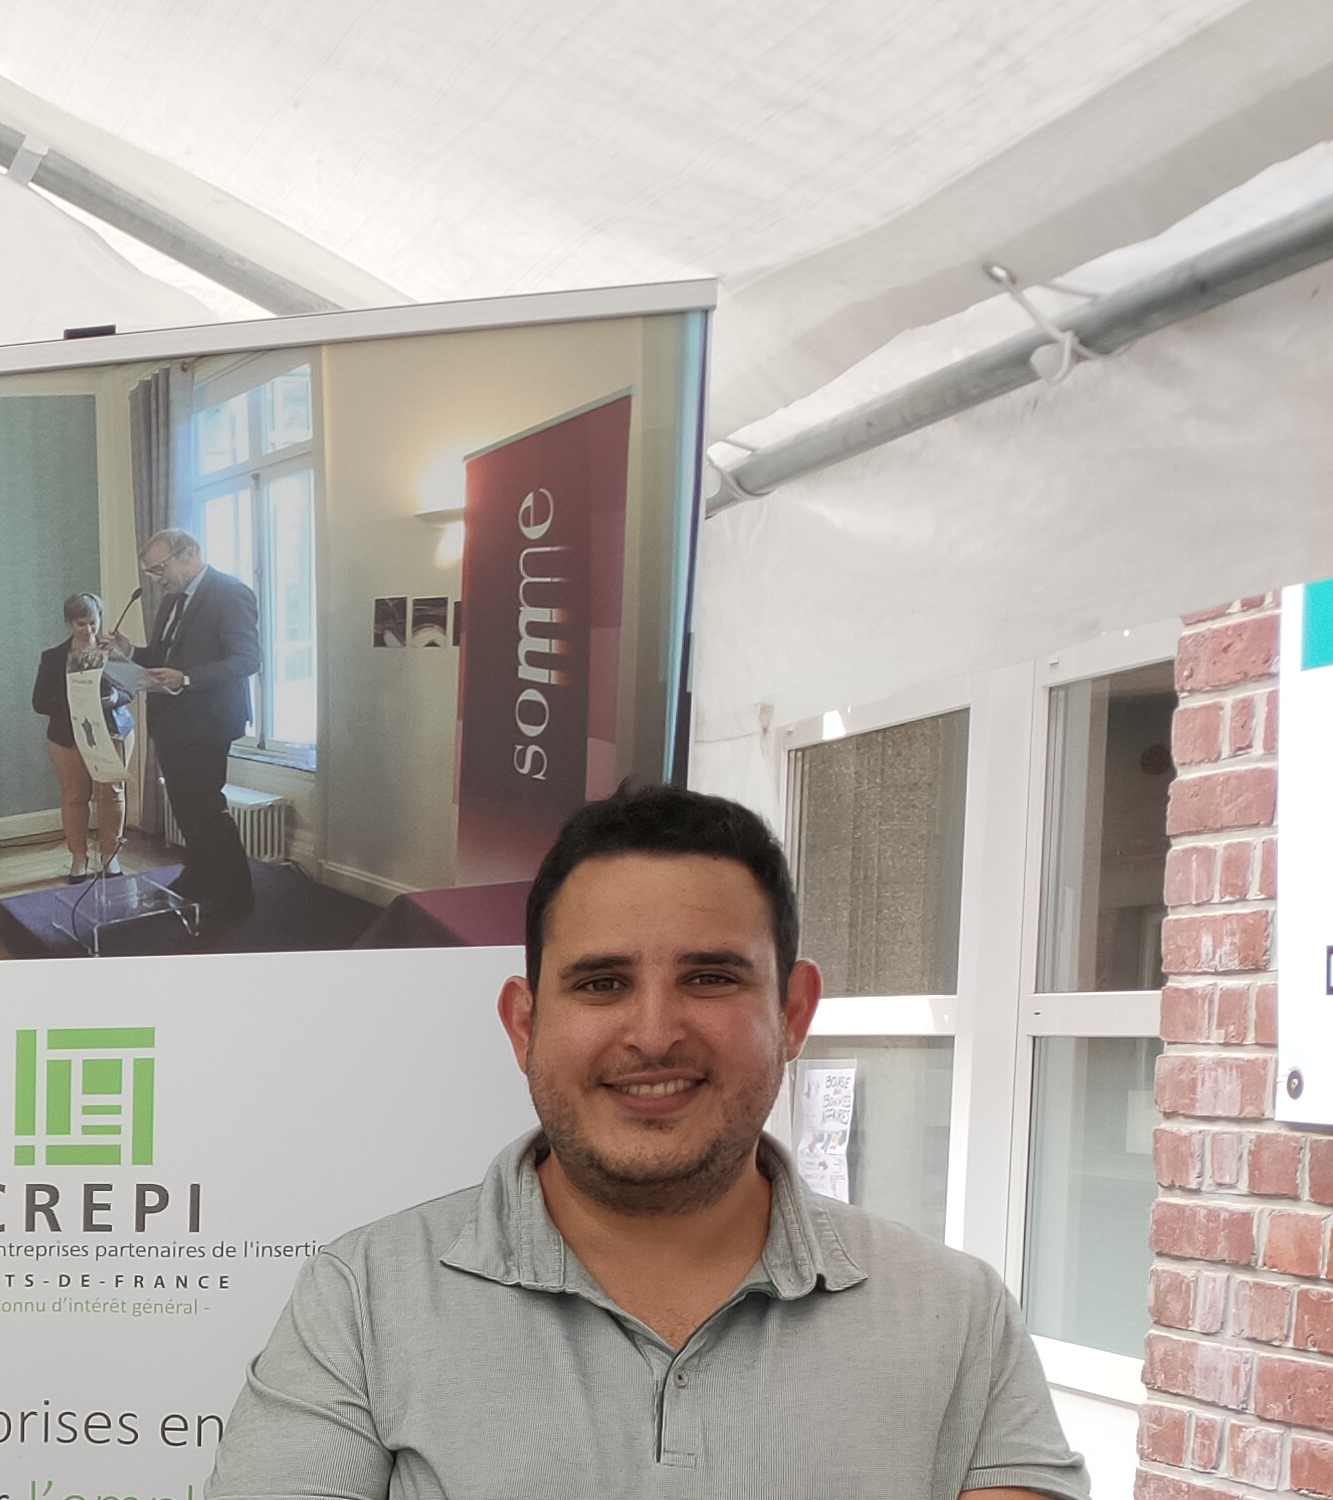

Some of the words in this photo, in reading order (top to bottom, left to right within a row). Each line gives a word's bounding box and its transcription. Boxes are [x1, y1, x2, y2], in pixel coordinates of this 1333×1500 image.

[513, 487, 567, 782] somme
[95, 1242, 206, 1263] partenaires
[211, 1242, 237, 1260] de
[52, 1296, 128, 1314] d'intérêt
[132, 1297, 197, 1317] général
